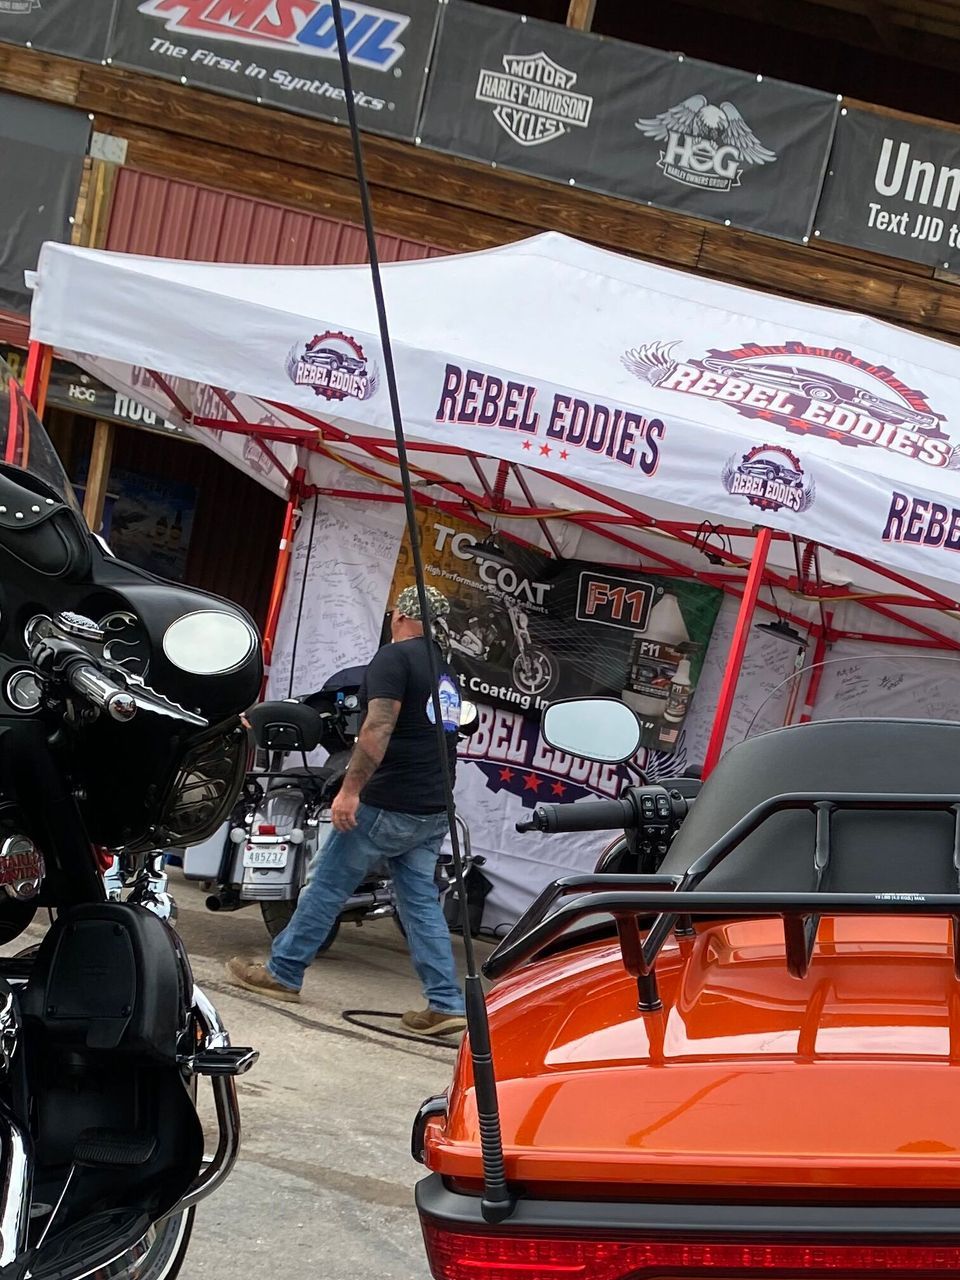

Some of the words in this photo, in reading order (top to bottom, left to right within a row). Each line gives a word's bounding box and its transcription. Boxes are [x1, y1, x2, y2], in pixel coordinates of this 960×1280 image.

[149, 37, 188, 59] The
[190, 49, 241, 73] First
[247, 62, 267, 80] in
[511, 58, 567, 89] MOTOR
[482, 75, 587, 121] HARLEY-DAVIDSON
[501, 107, 557, 141] CYCLES
[662, 130, 740, 180] HOG
[867, 202, 910, 235] Text
[910, 214, 945, 243] JJD
[794, 344, 862, 366] VEHICLE
[296, 361, 328, 386] REBEL
[435, 363, 541, 435] REBEL
[545, 392, 666, 478] EDDIE'S
[658, 361, 797, 418] REBEL
[800, 399, 952, 469] EDDIE'S
[731, 473, 764, 496] REBEL
[425, 563, 441, 577] High
[441, 569, 488, 592] Performance
[585, 581, 646, 624] F11
[640, 641, 661, 658] F11
[469, 677, 531, 711] Coating
